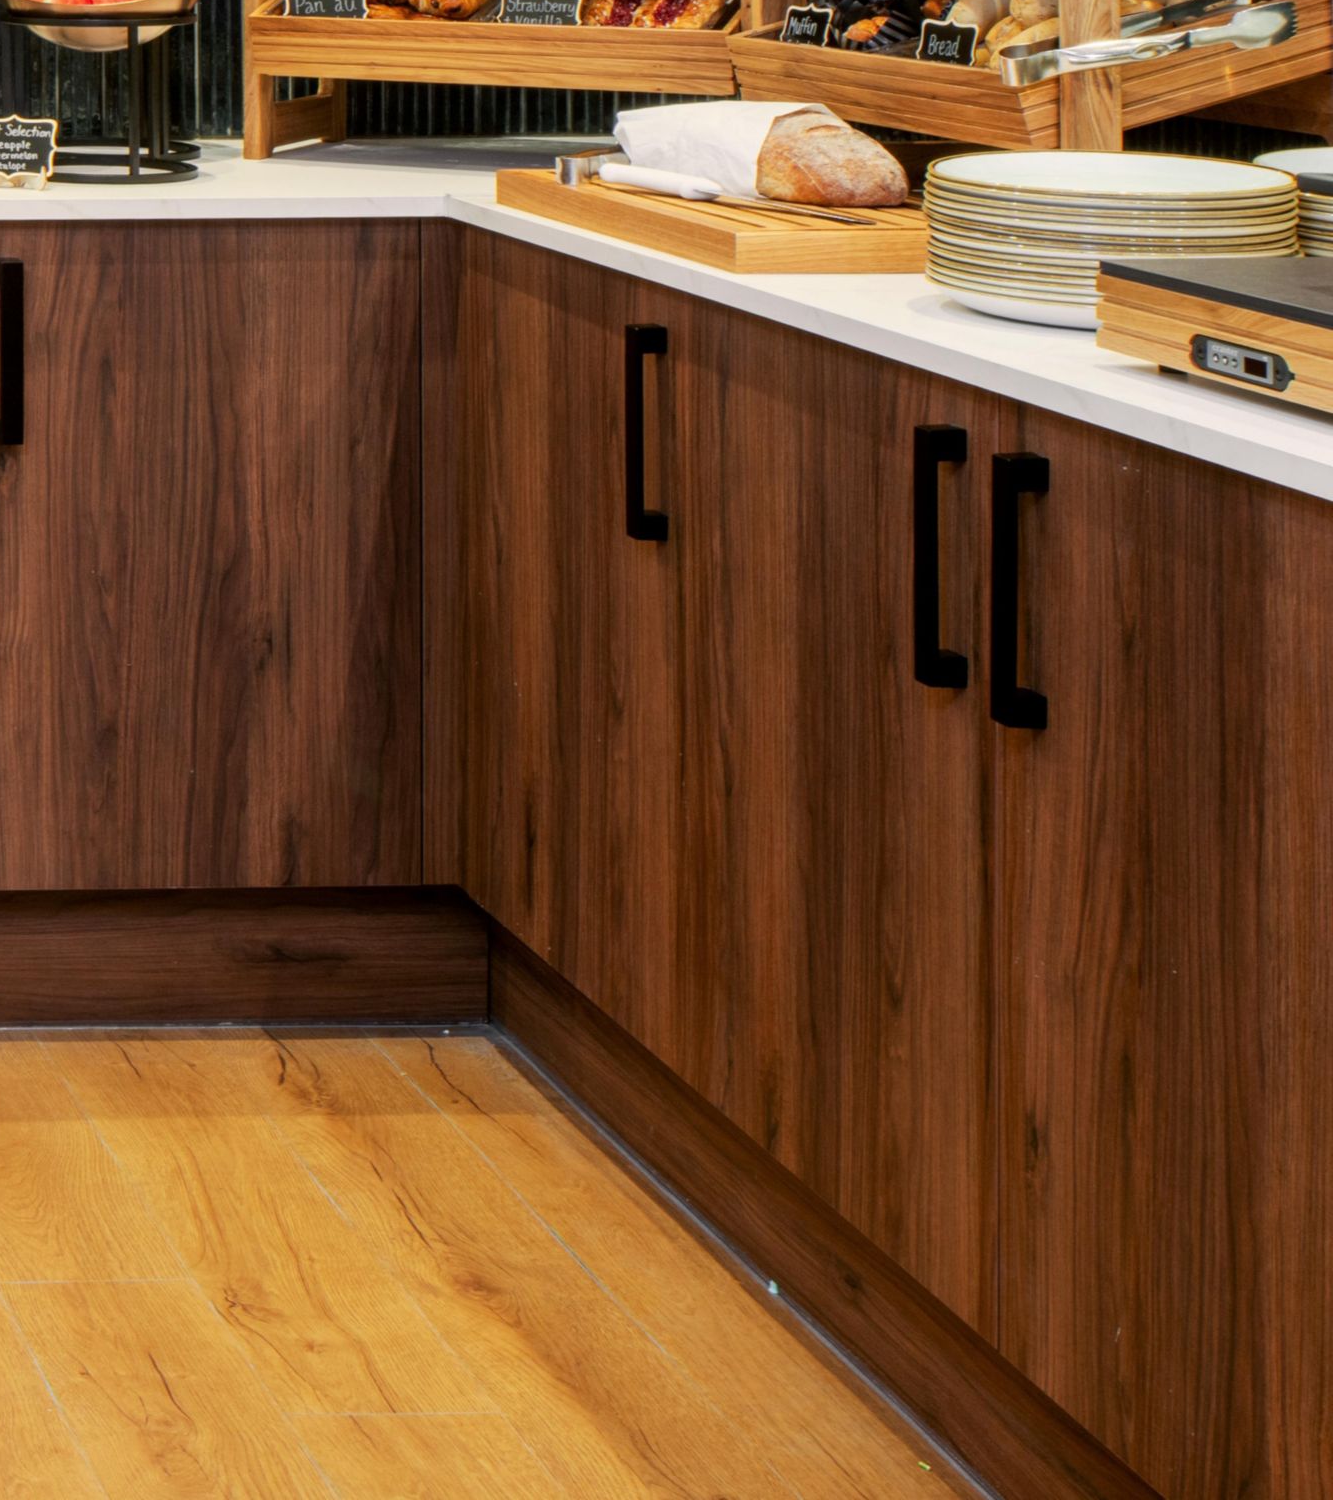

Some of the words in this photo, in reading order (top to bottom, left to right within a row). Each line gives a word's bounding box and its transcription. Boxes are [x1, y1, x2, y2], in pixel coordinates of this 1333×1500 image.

[787, 16, 818, 37] Muffin
[927, 34, 961, 58] Bread
[4, 123, 52, 138] Selection
